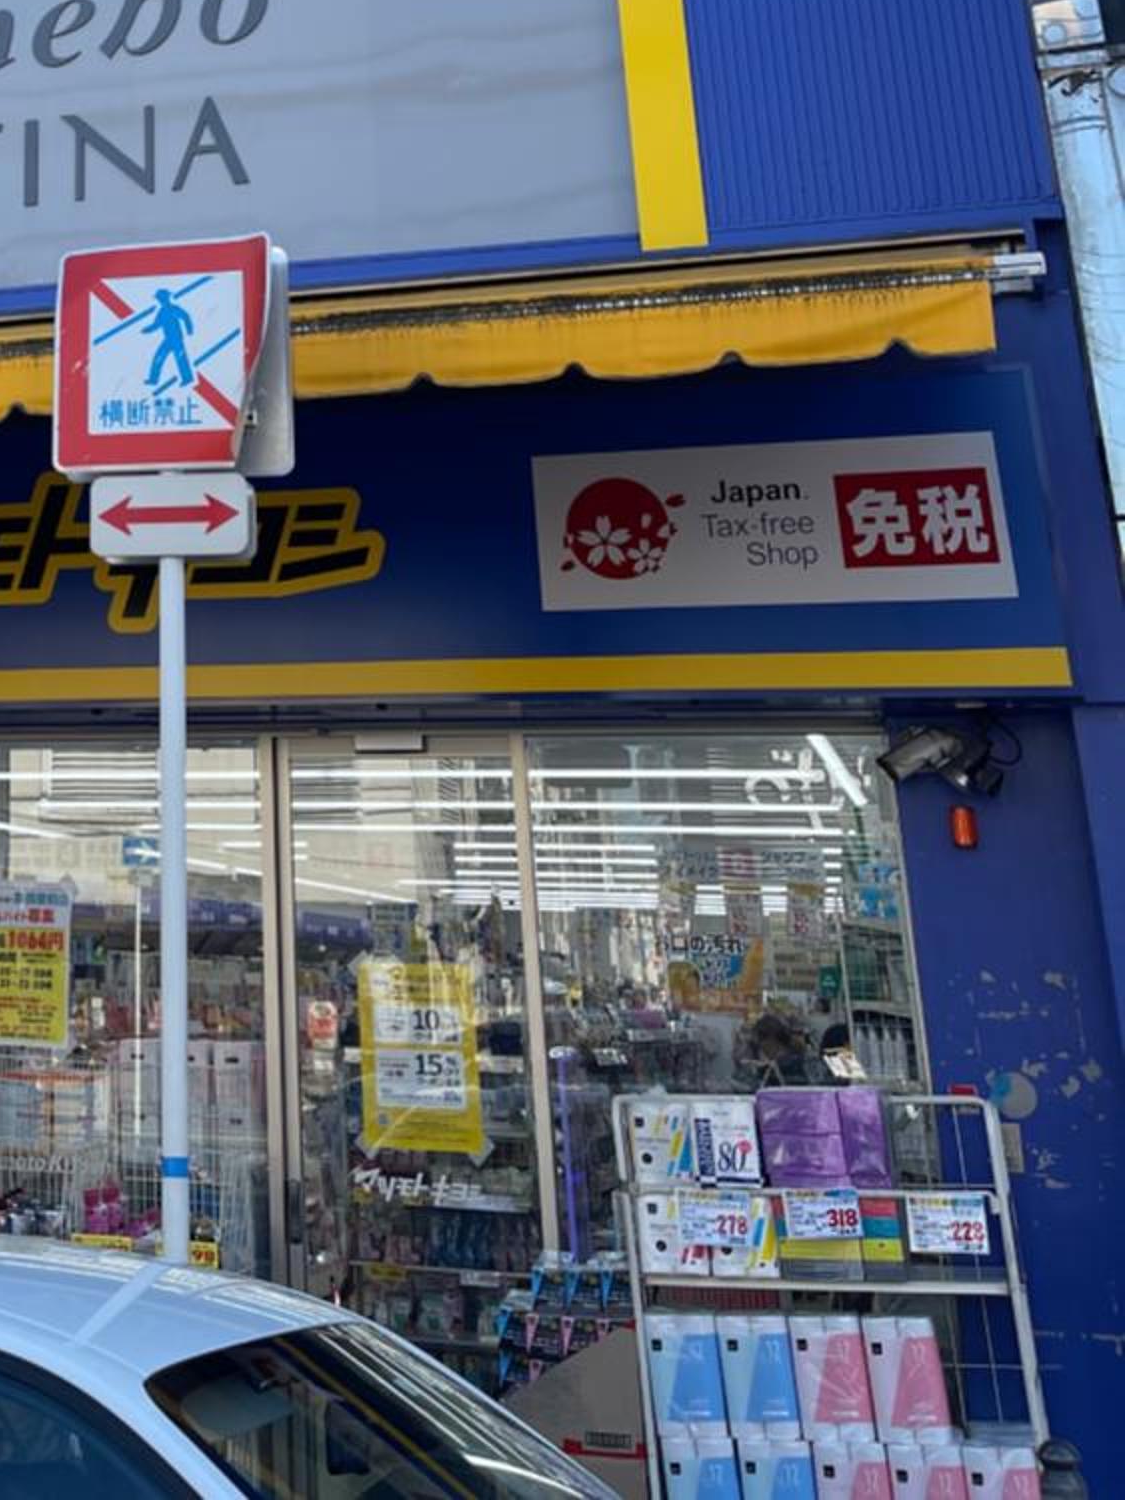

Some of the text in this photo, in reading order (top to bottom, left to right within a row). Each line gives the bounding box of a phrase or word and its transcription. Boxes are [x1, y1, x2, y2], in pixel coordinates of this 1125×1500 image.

[98, 396, 203, 427] 横断禁止
[701, 512, 814, 539] Tax-free
[846, 484, 991, 557] 免税
[747, 541, 819, 571] Shop
